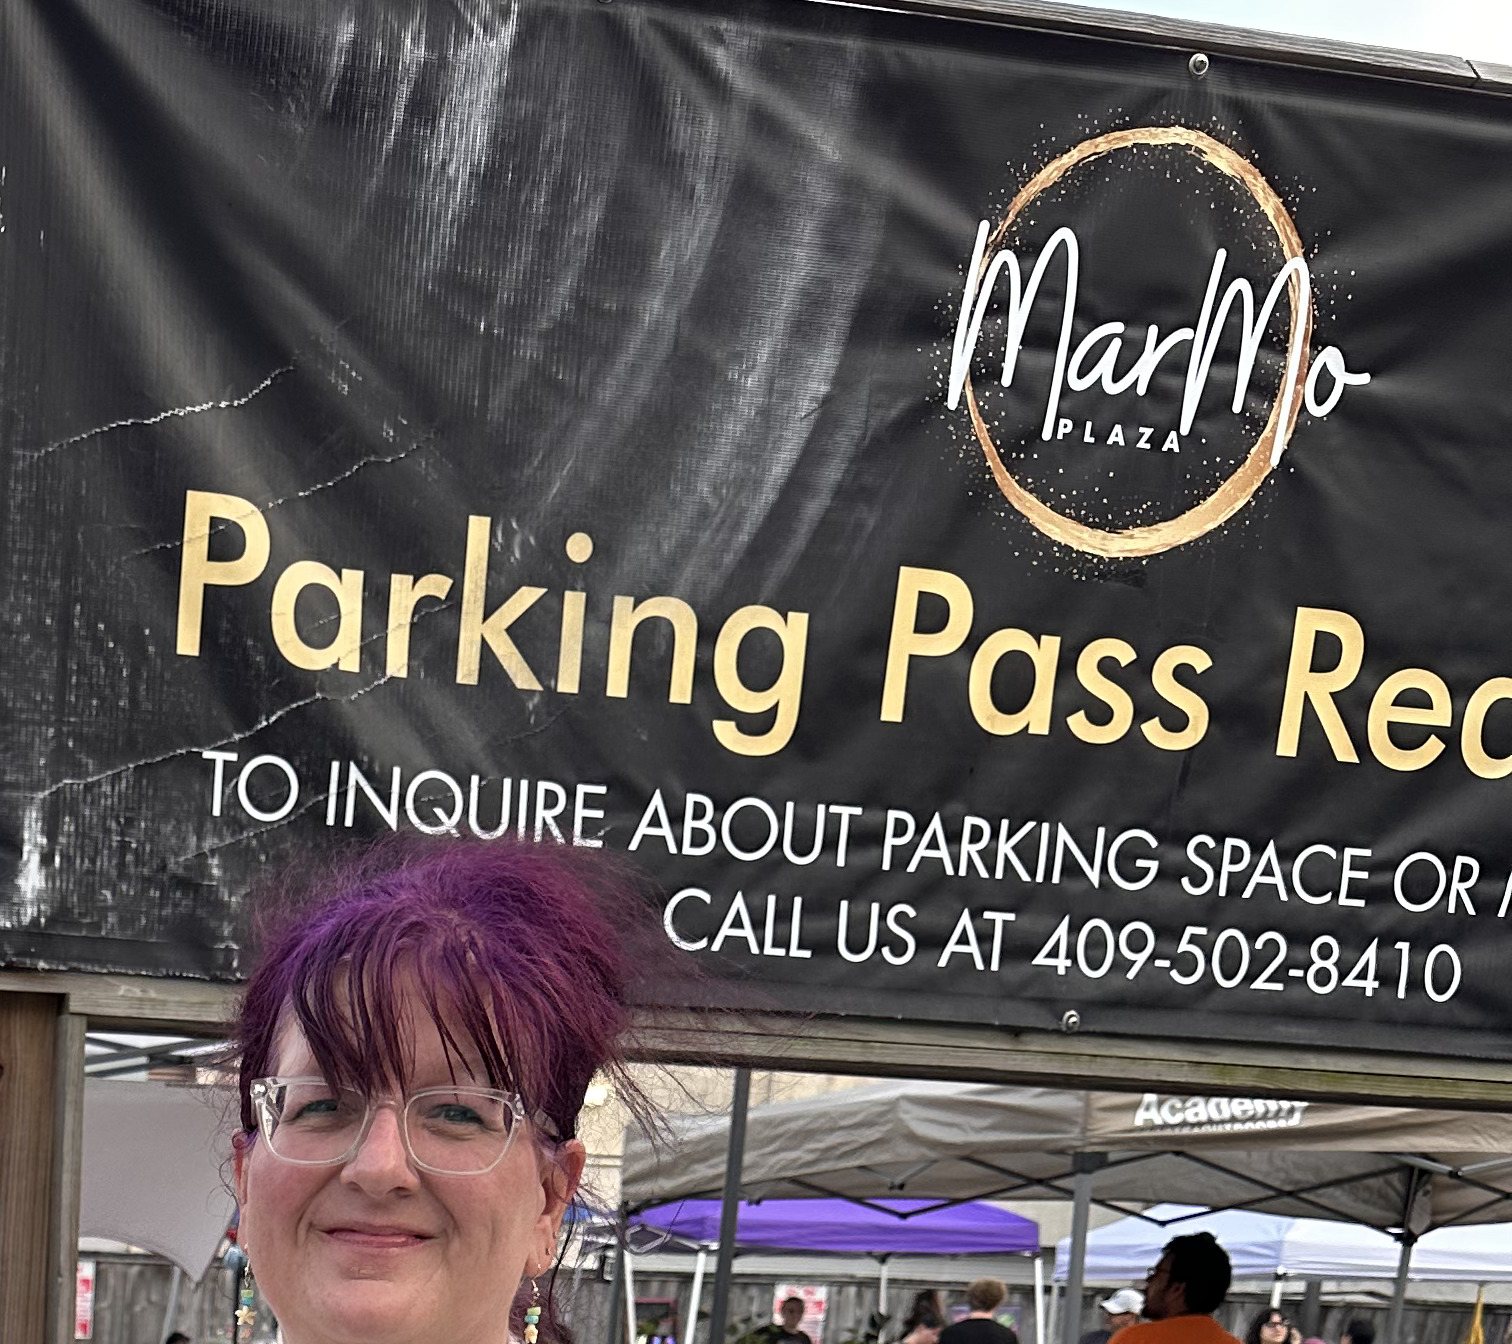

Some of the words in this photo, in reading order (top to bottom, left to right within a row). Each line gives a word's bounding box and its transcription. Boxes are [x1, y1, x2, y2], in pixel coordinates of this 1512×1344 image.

[947, 219, 1371, 467] MarMo
[1057, 418, 1180, 453] PLAZA
[175, 489, 810, 757] Parking
[880, 565, 1213, 751] Pass
[201, 750, 299, 823] TO
[325, 760, 609, 848] INQUIRE
[627, 789, 863, 867] ABOUT
[881, 809, 1160, 892] PARKING
[1181, 834, 1372, 907] SPACE
[1394, 851, 1480, 916] OR
[663, 888, 812, 959] CALL
[836, 900, 918, 966] US
[937, 907, 1016, 972] AT
[1031, 915, 1462, 1003] 409-502-8410
